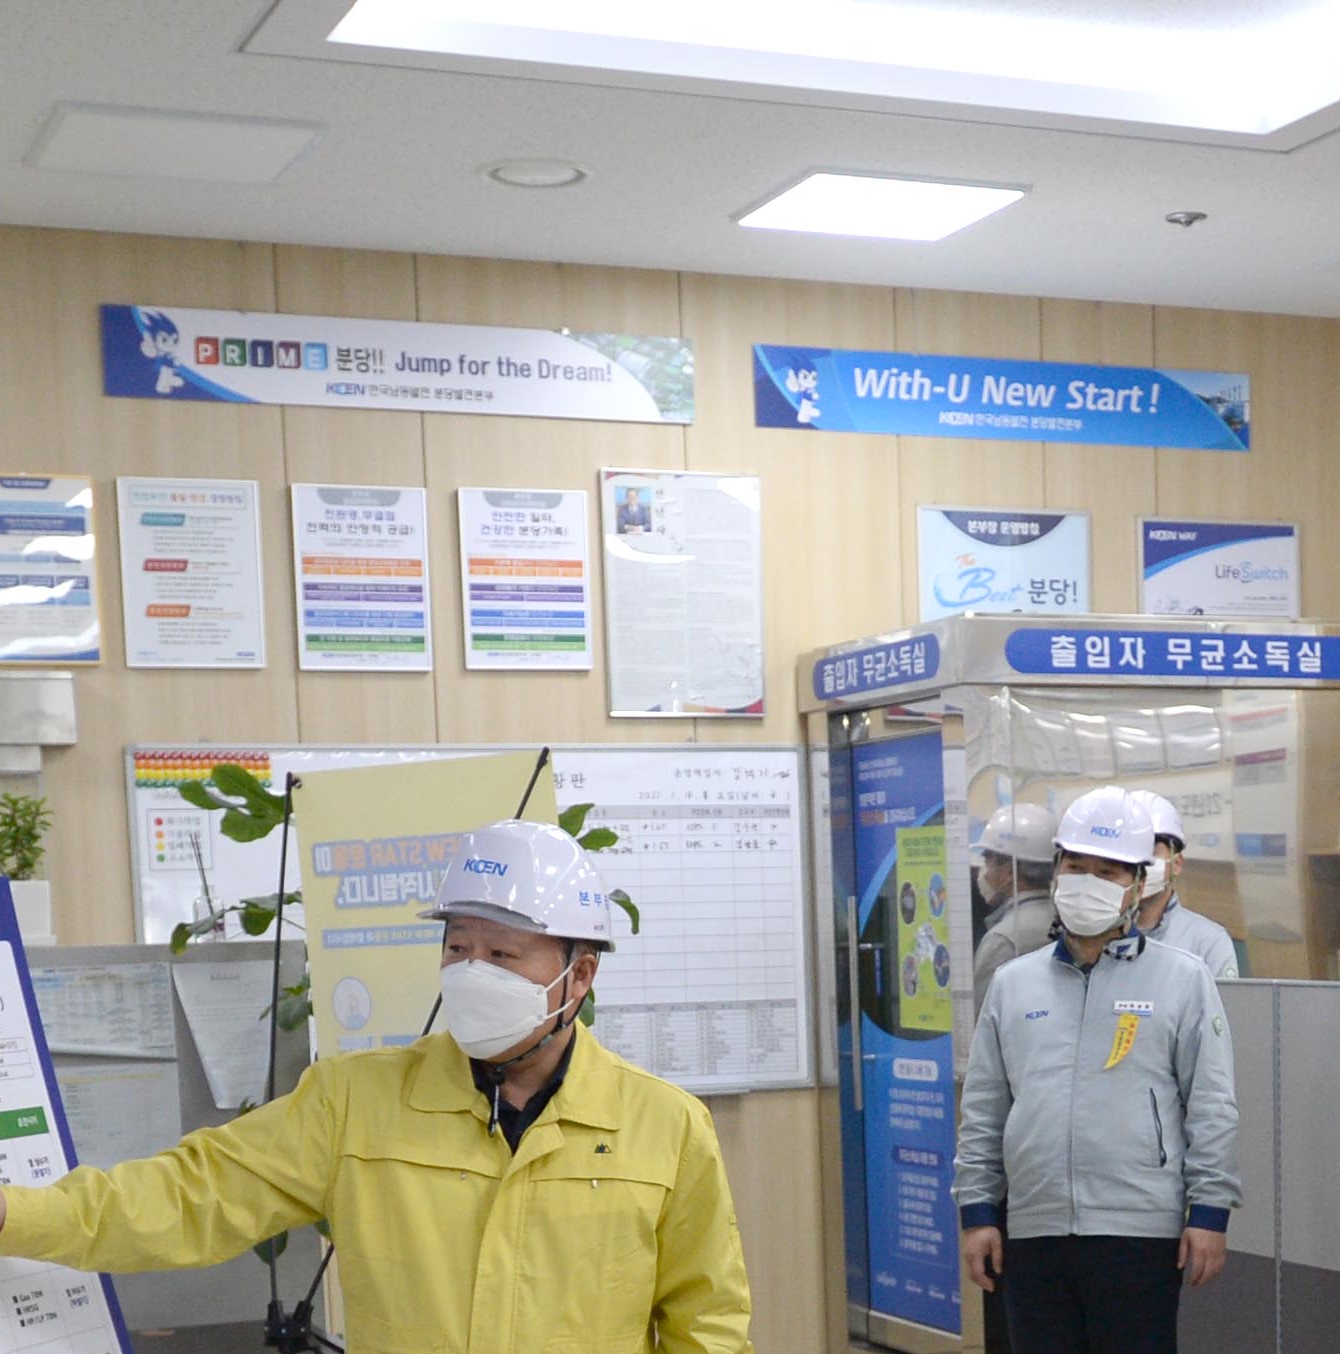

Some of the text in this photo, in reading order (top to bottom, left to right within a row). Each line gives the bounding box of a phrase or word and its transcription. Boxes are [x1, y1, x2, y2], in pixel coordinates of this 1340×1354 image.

[195, 338, 328, 371] PRIME
[395, 351, 452, 379] Jump
[459, 355, 490, 377] for
[496, 356, 531, 379] the
[537, 359, 614, 383] Dream!
[853, 367, 970, 403] With-U
[982, 375, 1056, 408] New
[1027, 578, 1078, 605] 분당!
[1049, 635, 1324, 675] 출입자 무균소독실
[463, 858, 508, 877] KOEN
